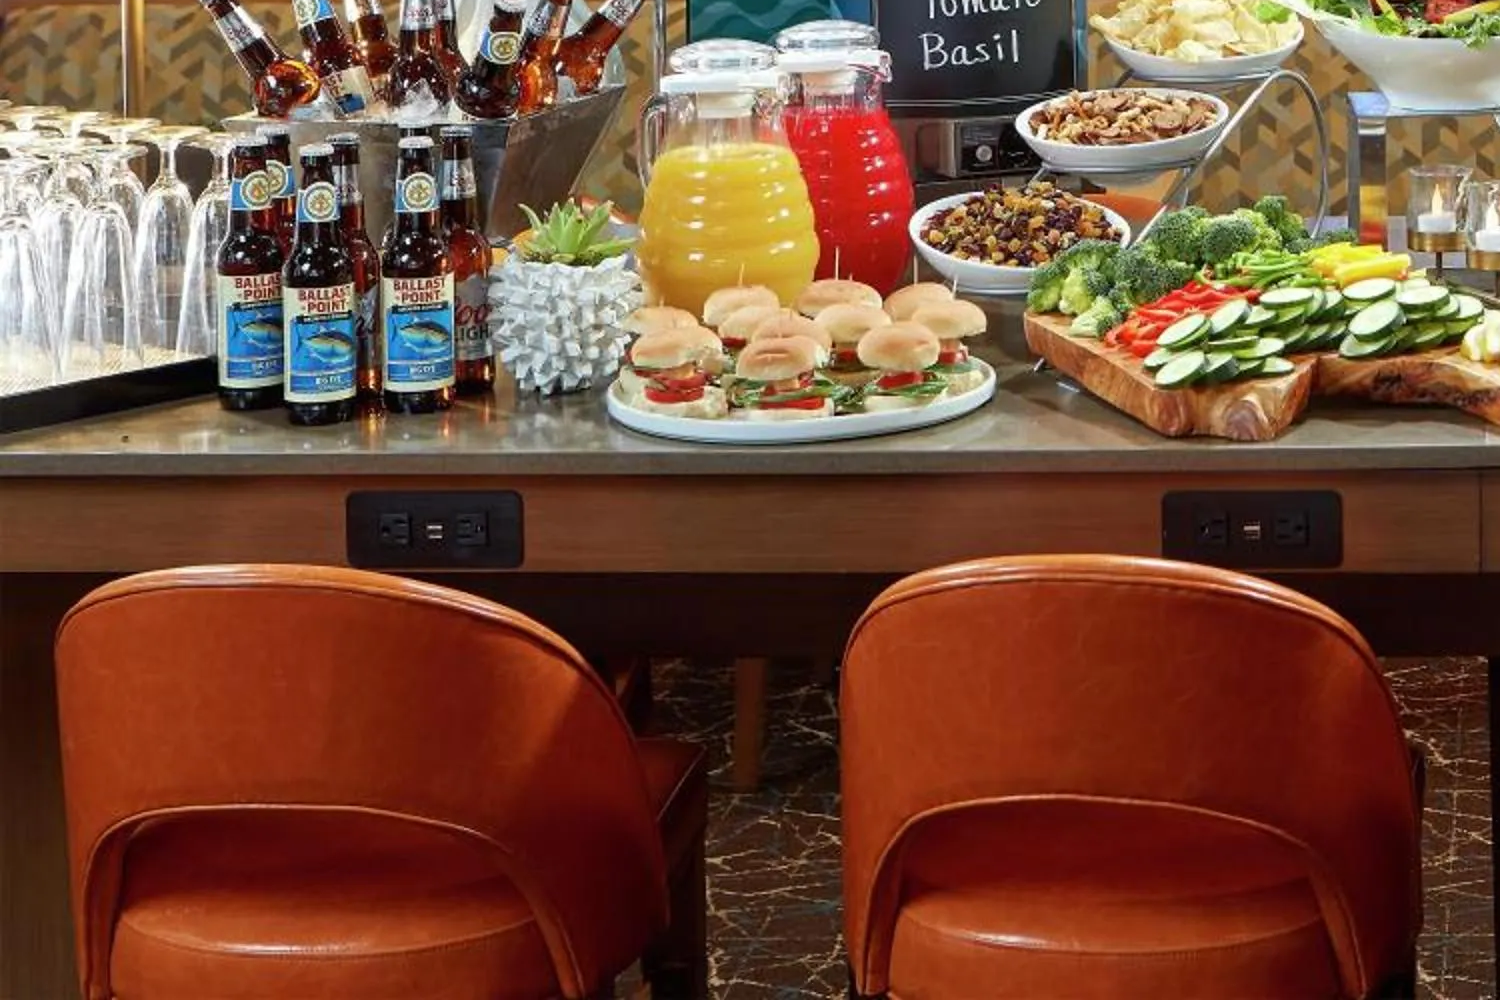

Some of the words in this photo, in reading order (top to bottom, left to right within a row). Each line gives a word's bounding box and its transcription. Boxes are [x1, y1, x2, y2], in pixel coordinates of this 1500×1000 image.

[918, 28, 1019, 71] Basil
[234, 274, 282, 289] BALLAS
[393, 278, 445, 291] BALLAST
[401, 291, 441, 303] POINT
[307, 299, 347, 313] POINT
